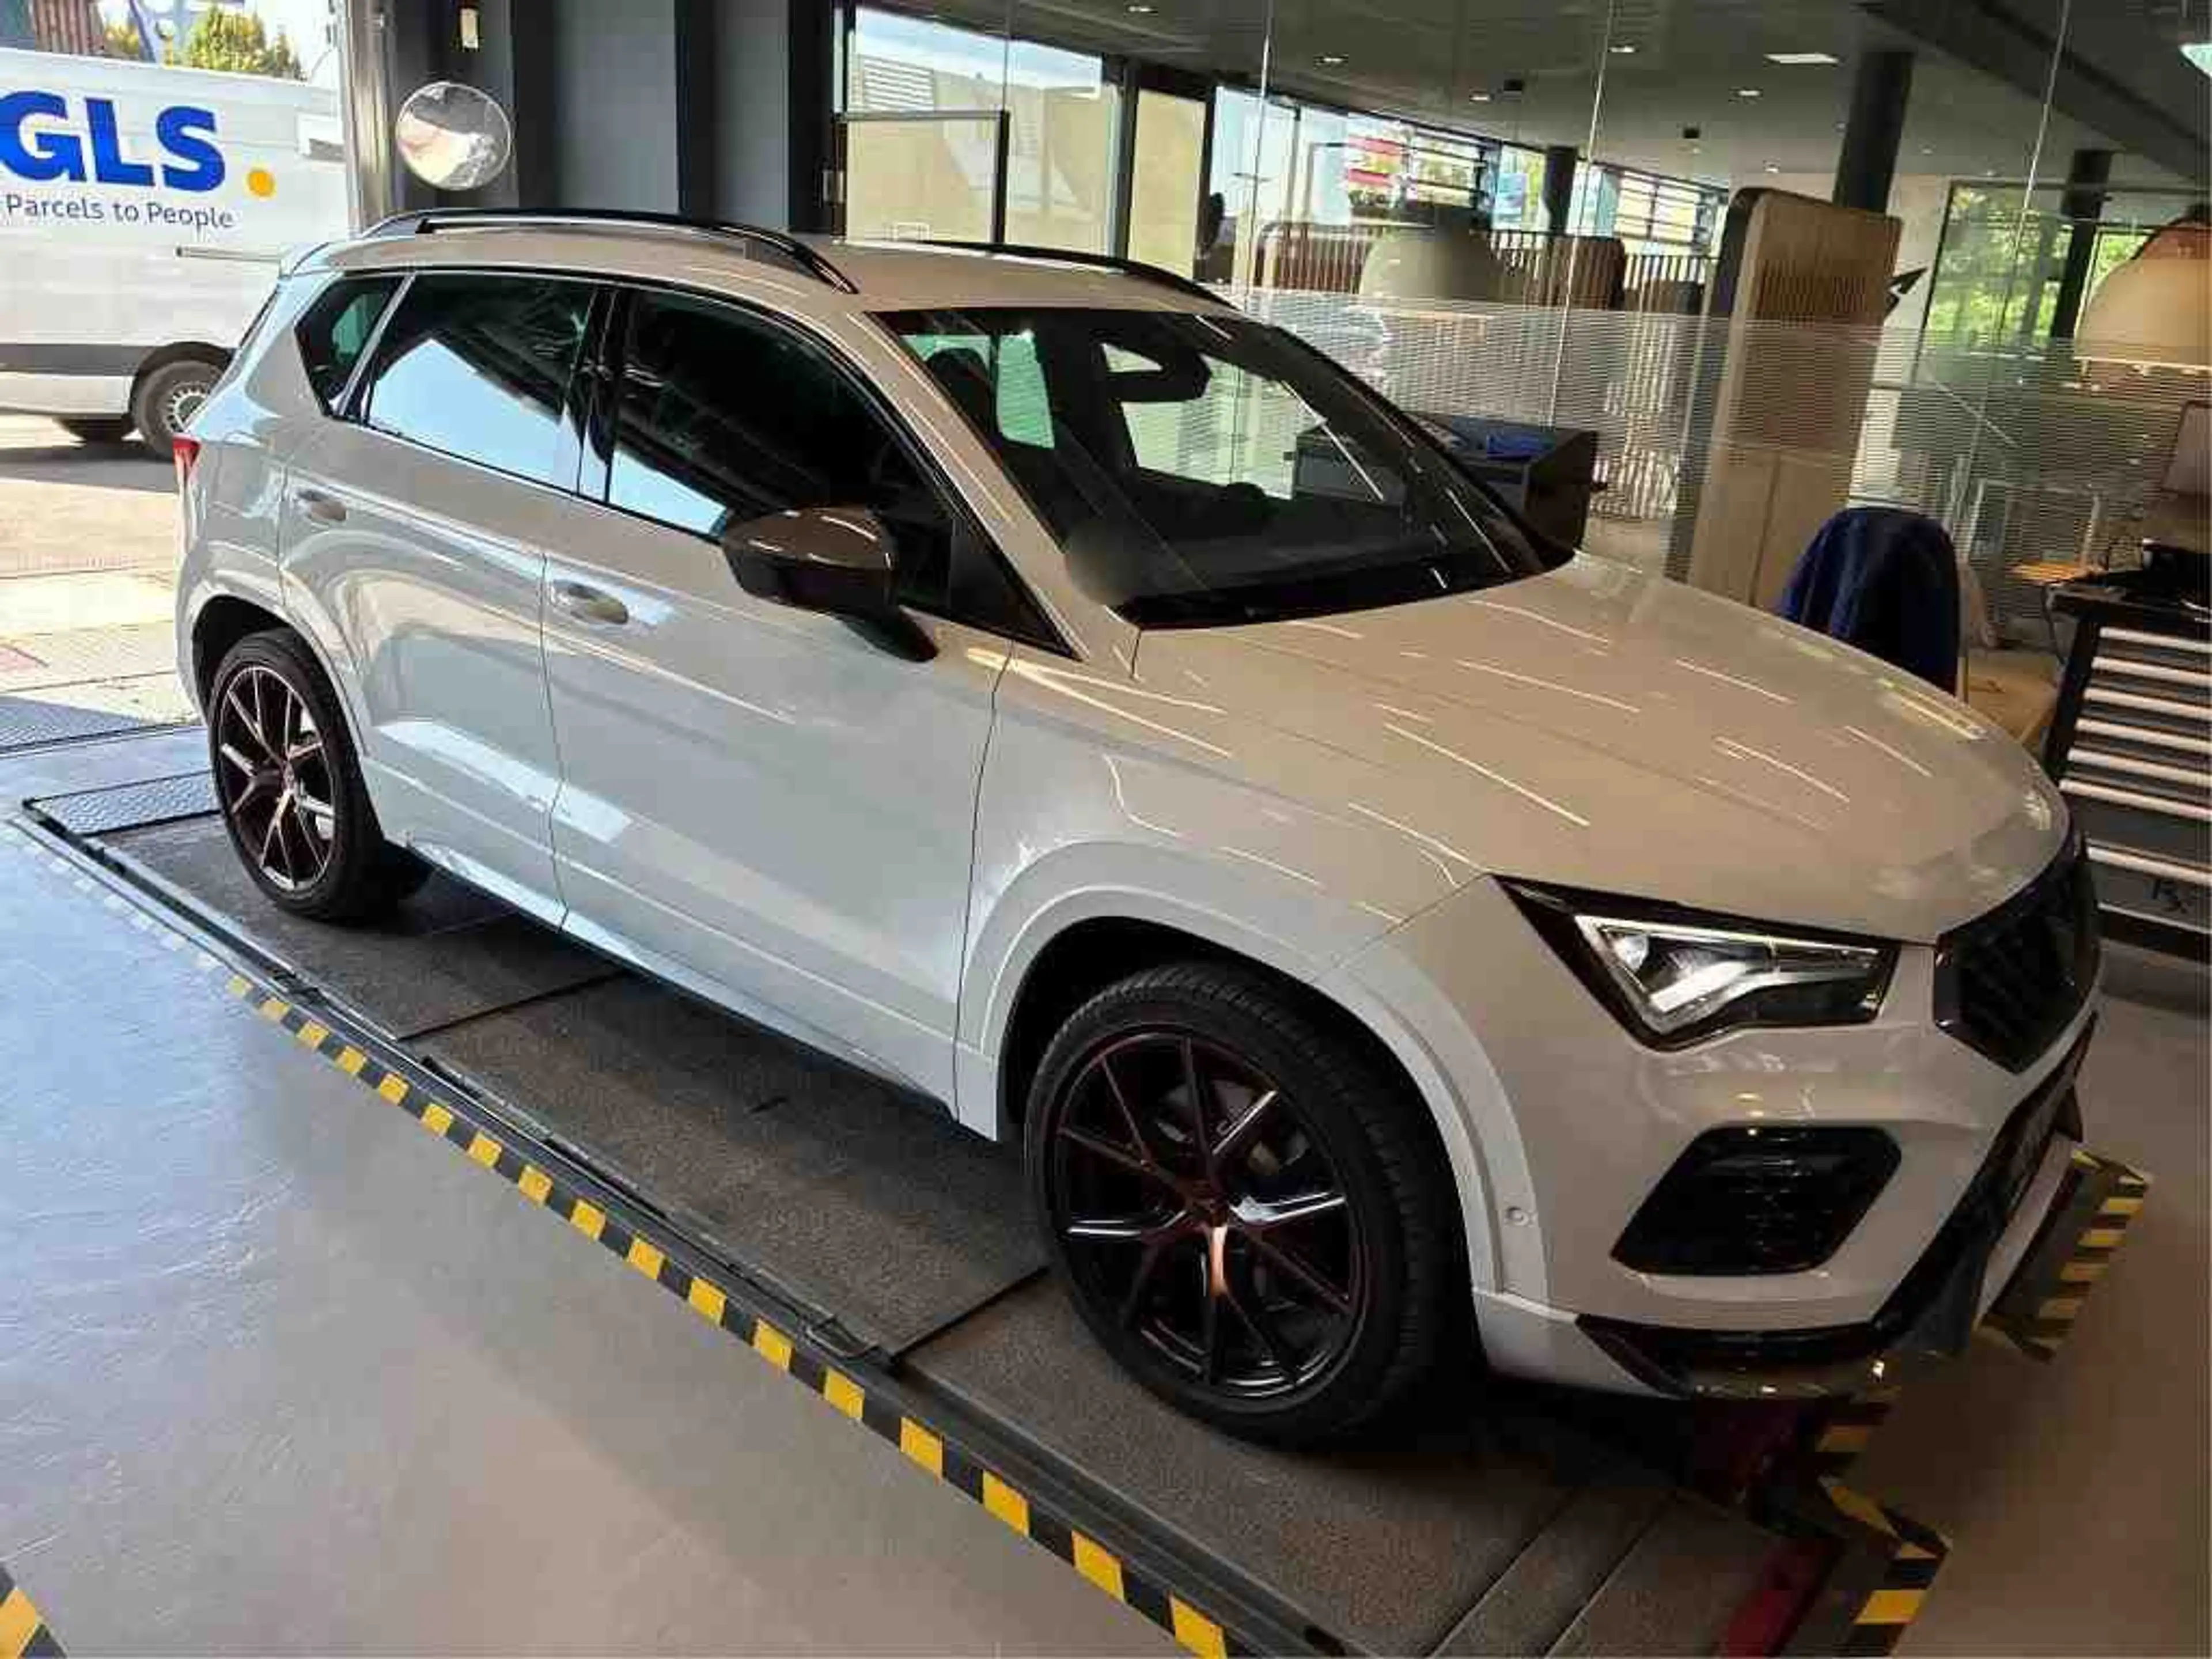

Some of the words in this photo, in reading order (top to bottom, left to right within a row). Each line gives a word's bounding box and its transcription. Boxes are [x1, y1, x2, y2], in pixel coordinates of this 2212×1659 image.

[0, 90, 226, 192] GLS
[6, 193, 105, 220] Parcels
[112, 202, 139, 222] to
[146, 202, 236, 232] People
